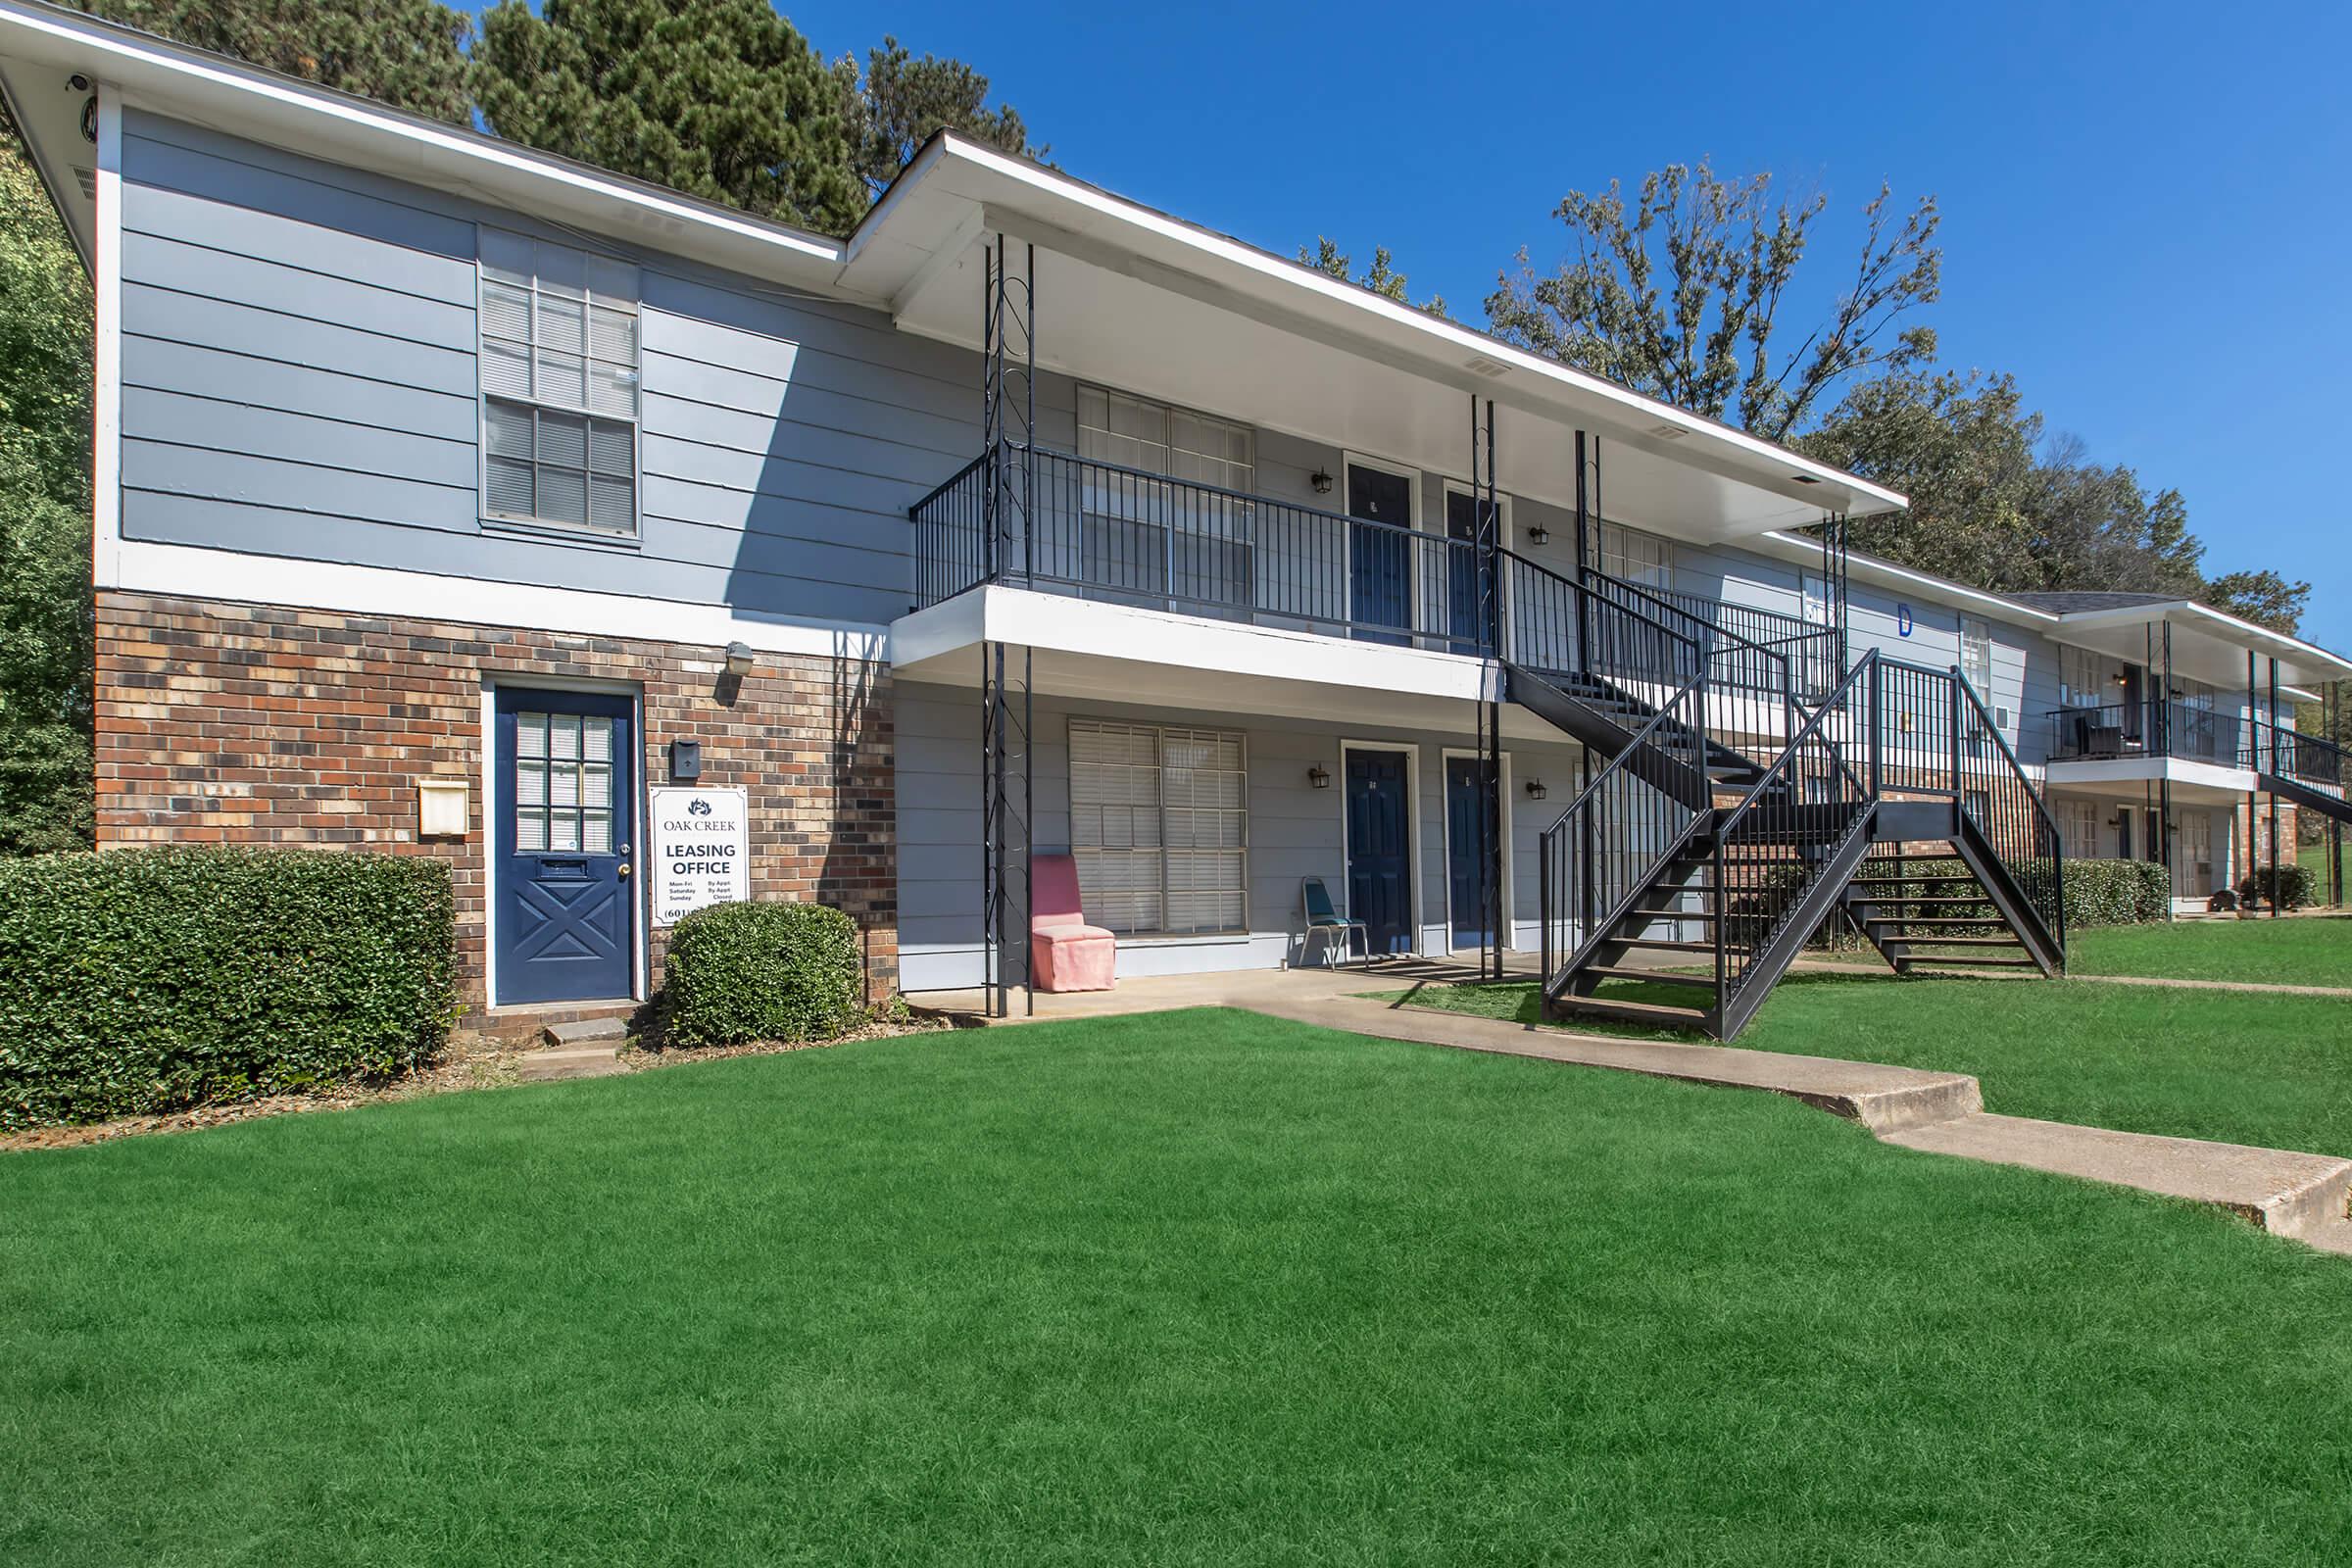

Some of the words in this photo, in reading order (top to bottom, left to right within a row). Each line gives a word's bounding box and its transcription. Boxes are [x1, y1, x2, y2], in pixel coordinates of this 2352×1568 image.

[1897, 603, 1913, 638] D
[663, 820, 692, 831] OAK
[694, 820, 735, 831] CREEK
[666, 845, 735, 857] LEASING
[672, 861, 730, 874] OFFICE
